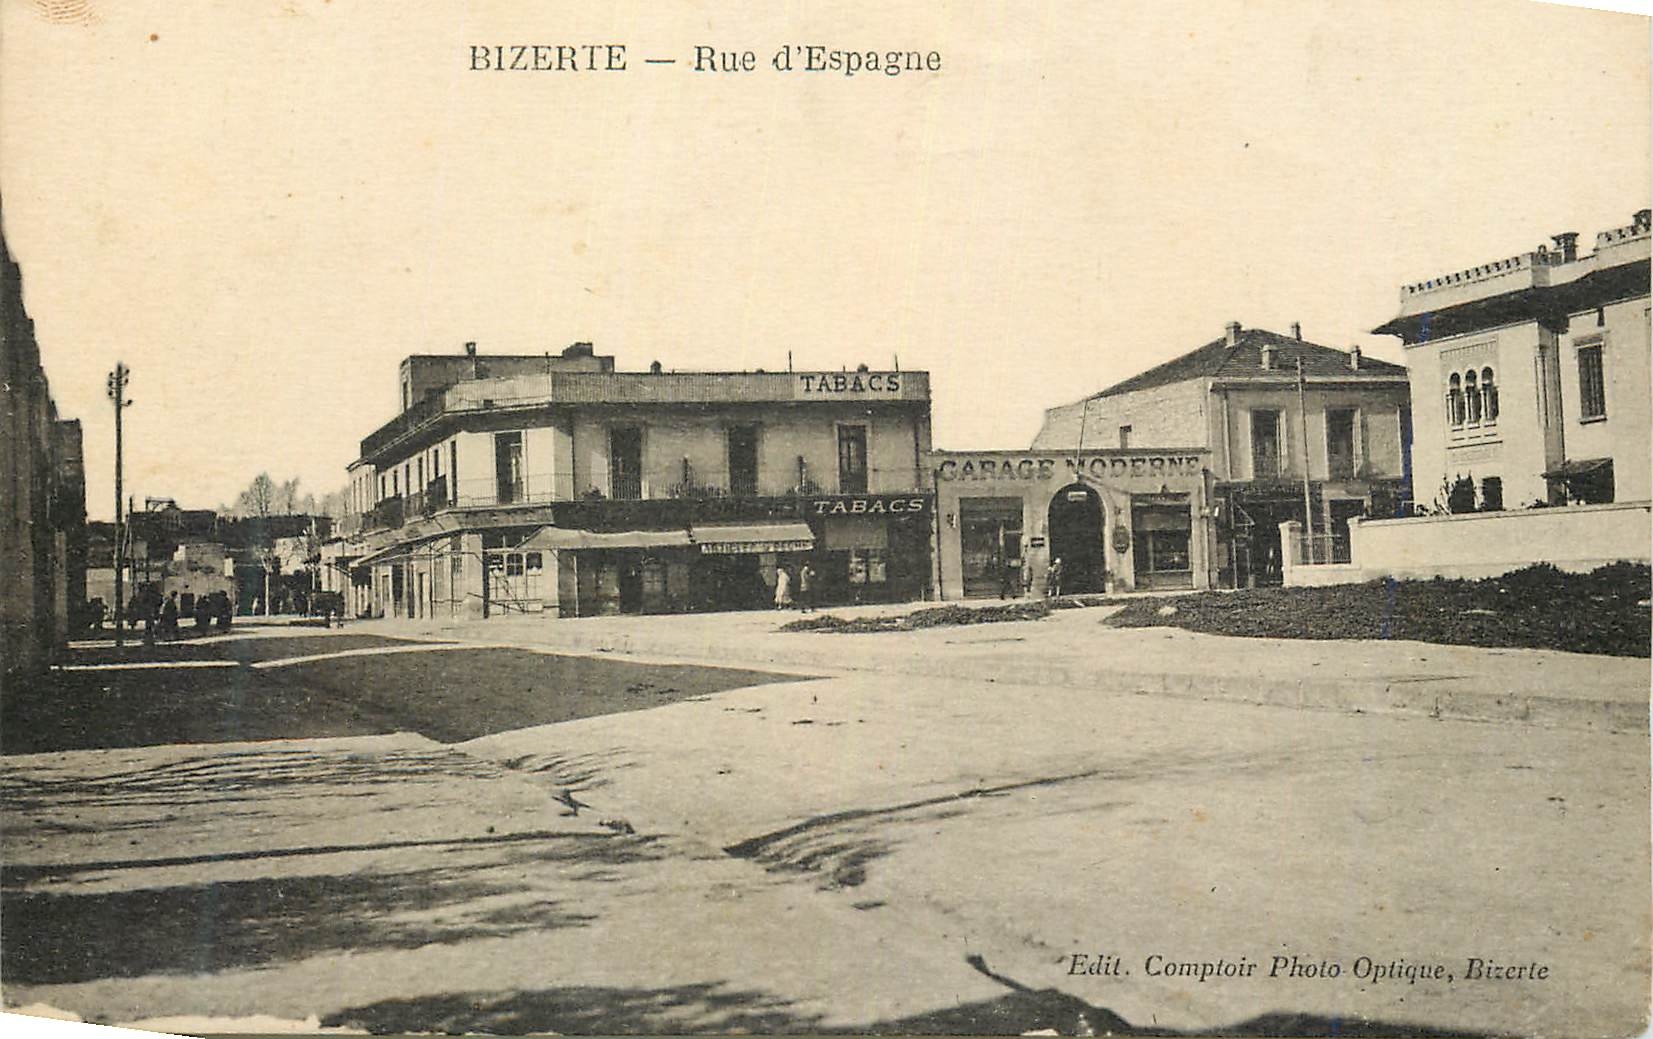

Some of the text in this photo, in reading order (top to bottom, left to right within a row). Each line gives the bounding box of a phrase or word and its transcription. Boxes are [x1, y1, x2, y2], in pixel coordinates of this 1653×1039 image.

[801, 374, 900, 393] TABACS
[939, 455, 1200, 482] GARAGE MODERNE
[814, 498, 924, 514] TABACS
